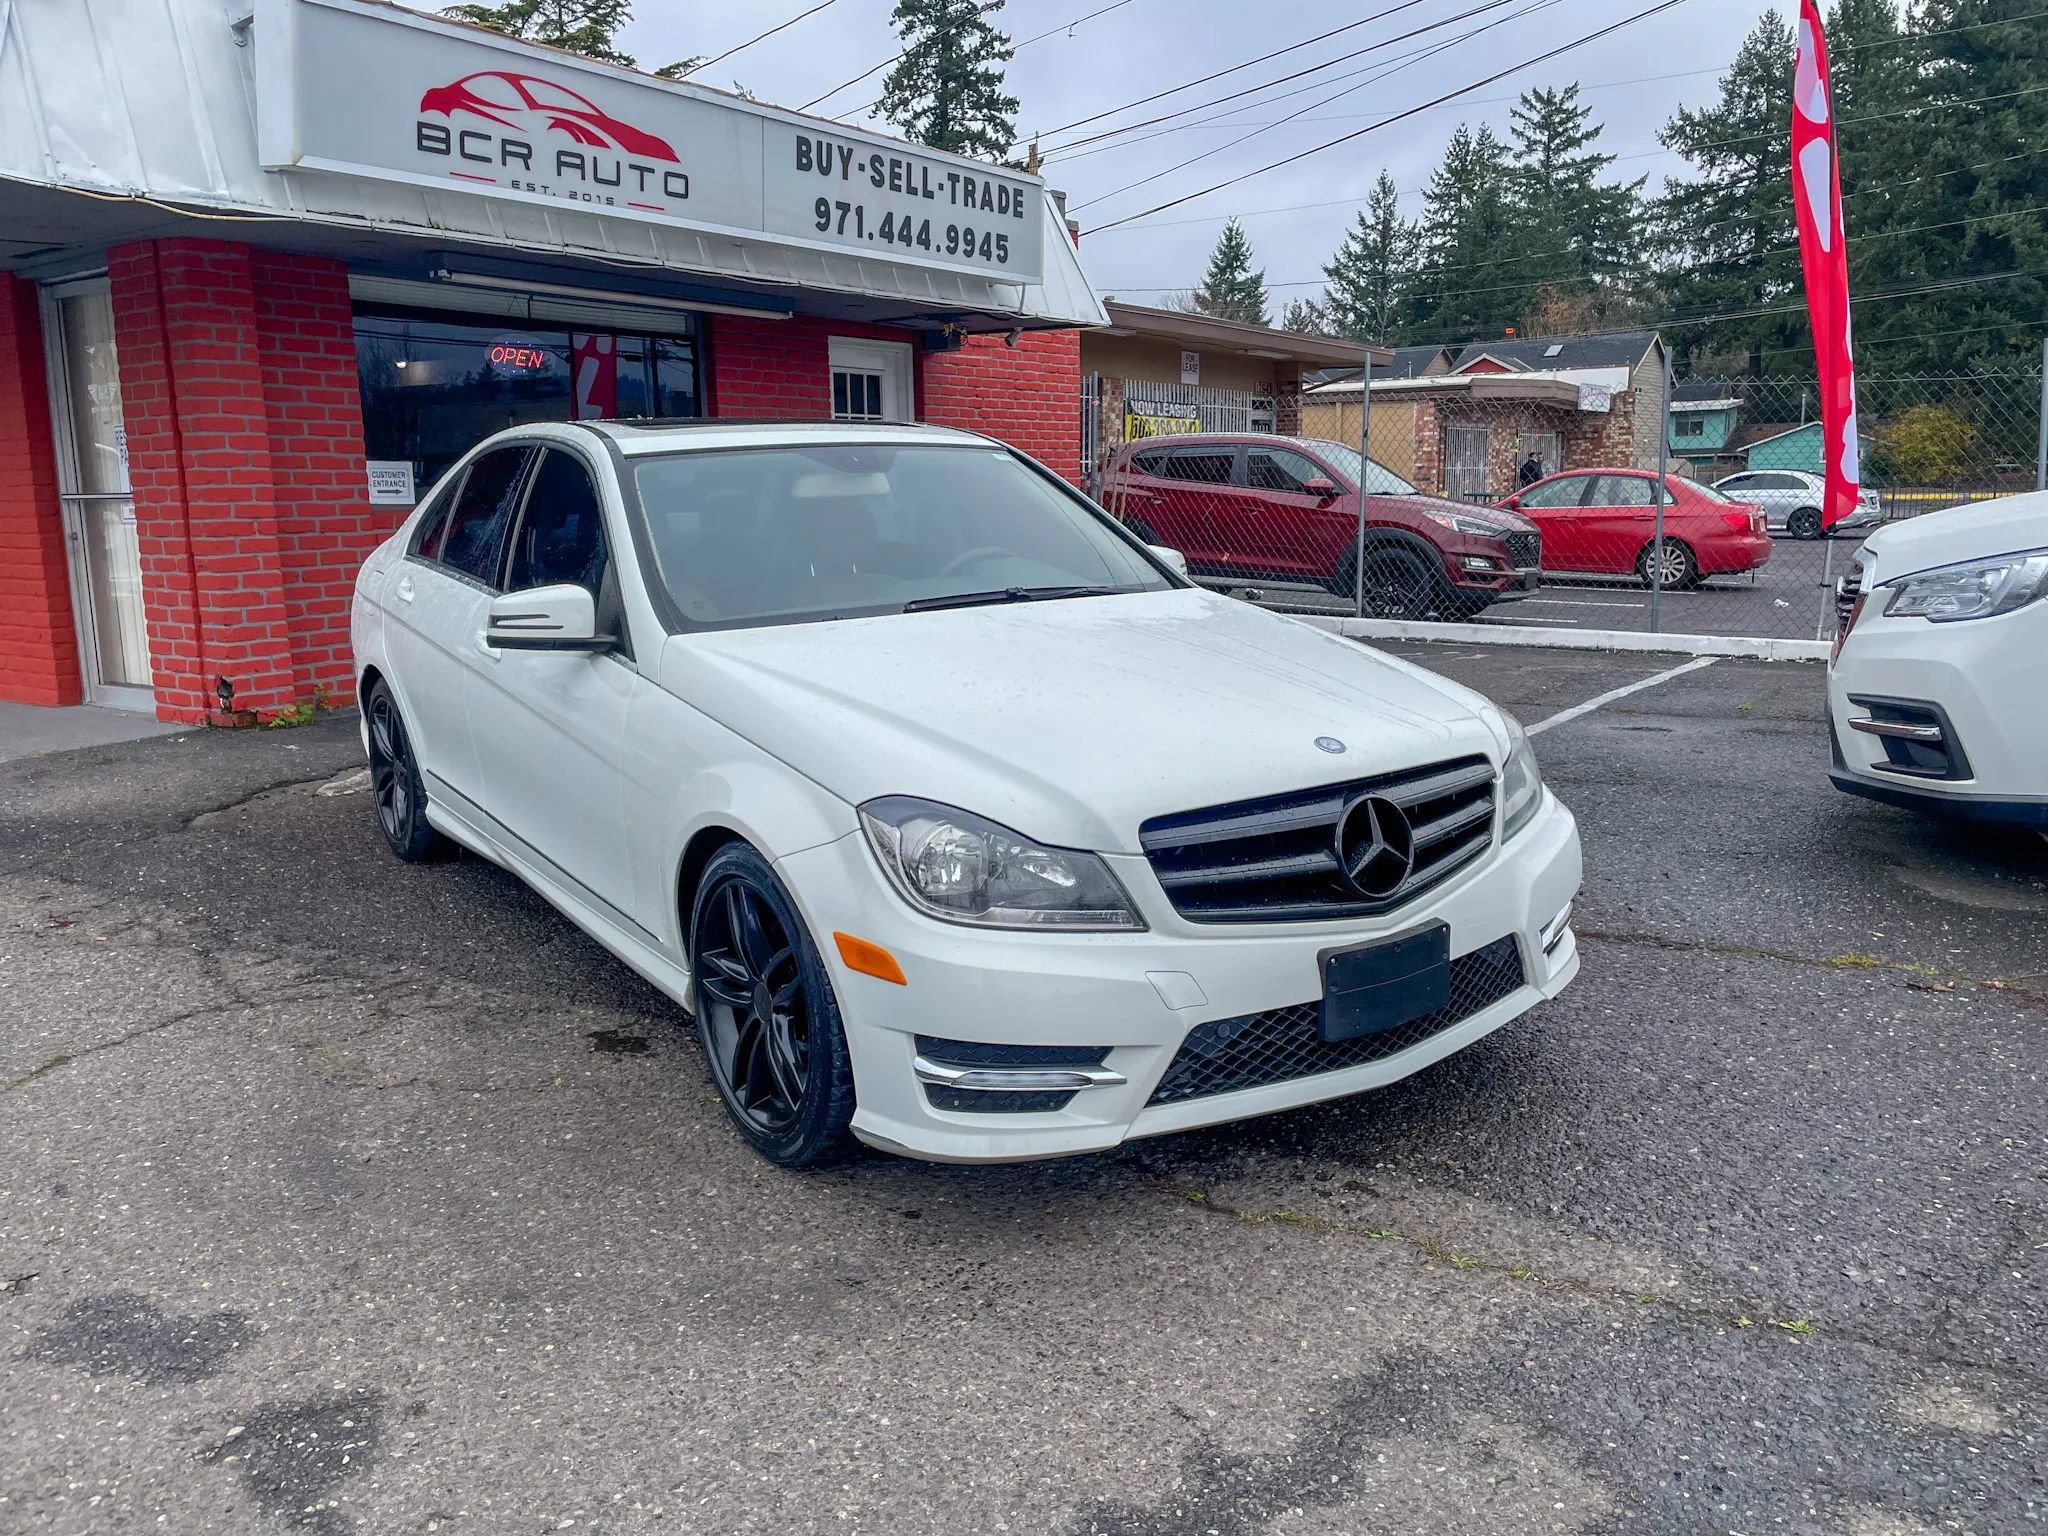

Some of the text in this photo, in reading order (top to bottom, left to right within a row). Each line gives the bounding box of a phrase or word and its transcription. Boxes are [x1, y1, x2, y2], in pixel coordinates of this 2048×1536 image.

[416, 120, 689, 200] BCR AUTO
[511, 180, 615, 206] EST. 2015
[814, 197, 1009, 264] 971.444.9945
[491, 346, 544, 369] OPEN
[1182, 363, 1199, 373] LEASE
[1157, 402, 1197, 418] LEASING
[371, 471, 406, 479] CUSTOMER
[372, 480, 407, 488] ENTRANCE
